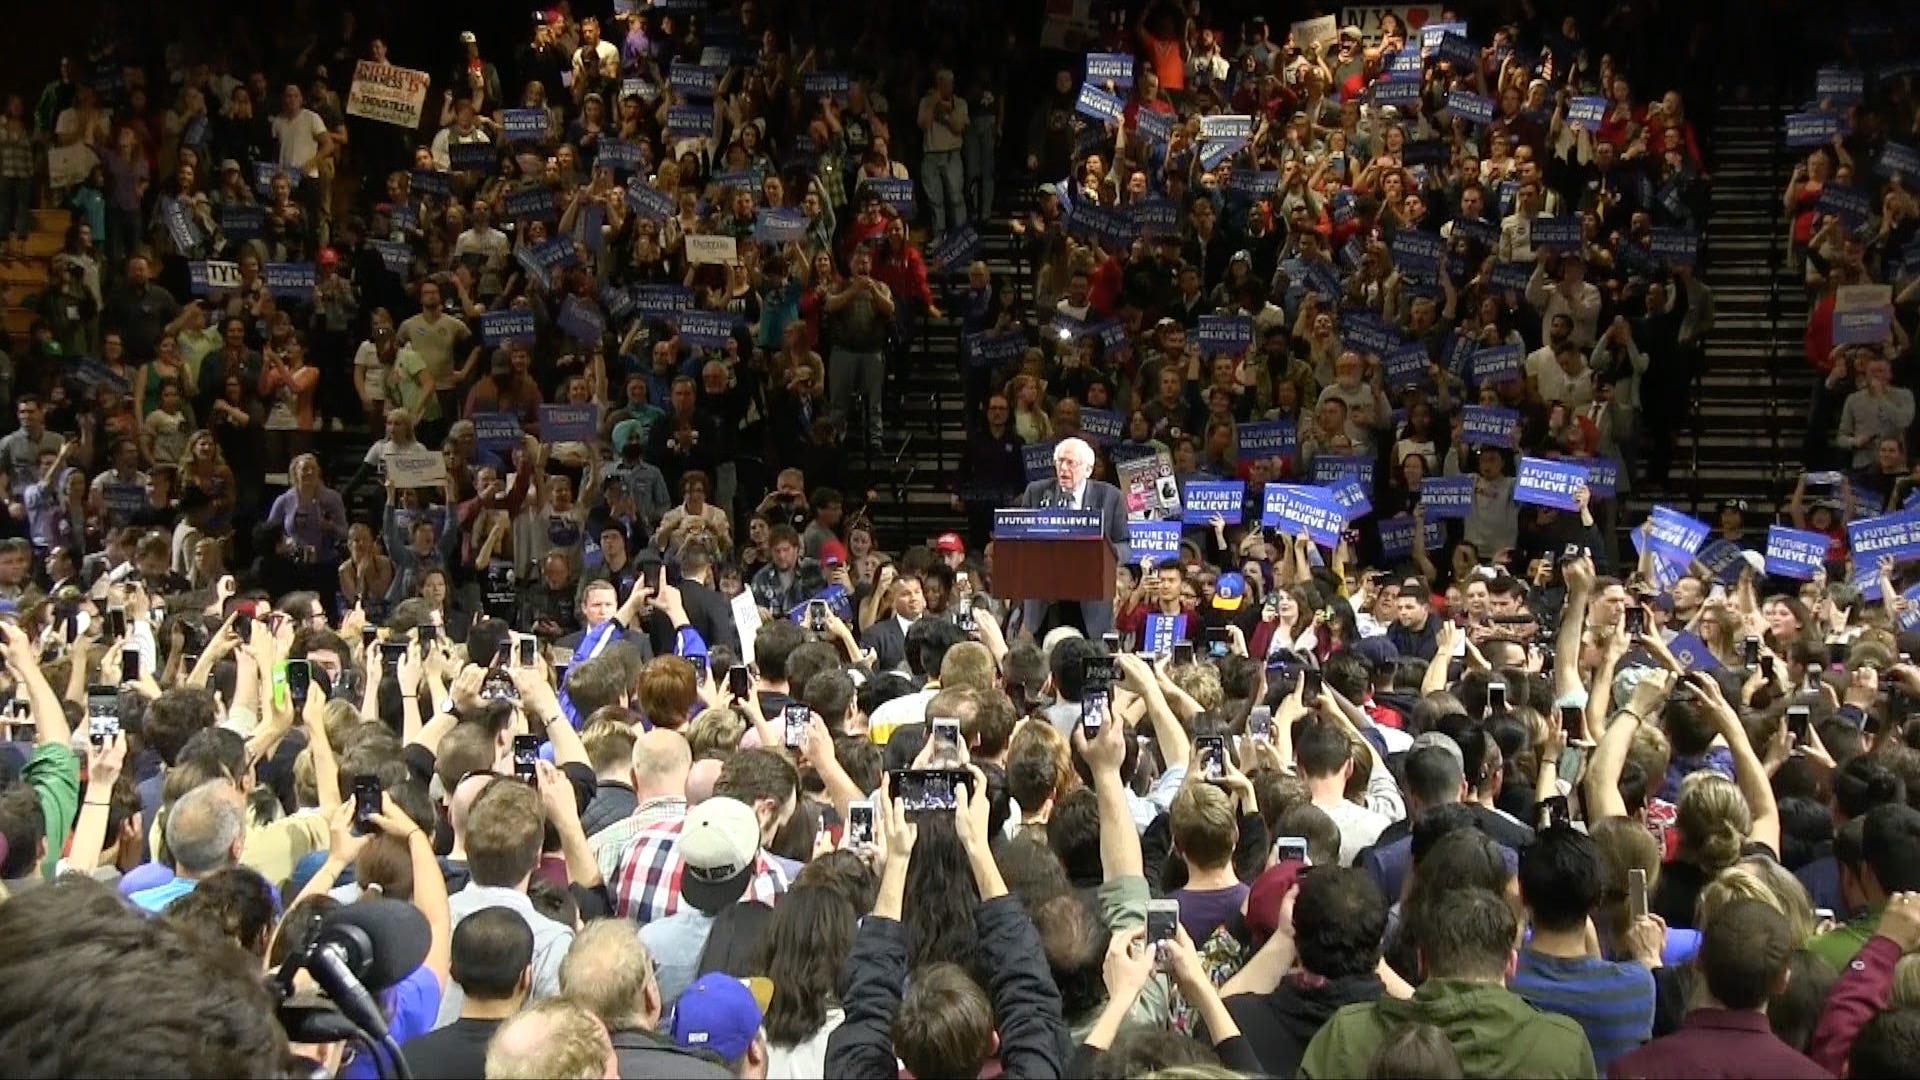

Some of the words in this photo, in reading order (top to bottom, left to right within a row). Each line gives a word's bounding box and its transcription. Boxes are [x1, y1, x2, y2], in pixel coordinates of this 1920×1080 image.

[485, 326, 522, 336] BELIEVE
[523, 324, 534, 332] IN
[681, 325, 719, 335] BELIEVE
[720, 328, 730, 337] IN
[1199, 330, 1237, 339] BELIEVE
[1239, 331, 1249, 340] IN
[1463, 422, 1501, 434] BELIEVE
[1241, 438, 1283, 448] BELIEVE
[1284, 436, 1296, 445] IN
[1360, 473, 1371, 482] IN
[1523, 467, 1529, 475] A
[1531, 469, 1567, 481] FUTURE
[1570, 476, 1584, 486] TO
[1603, 475, 1615, 485] IN
[1520, 476, 1566, 492] BELIEVE
[1188, 492, 1194, 500] A
[1196, 491, 1229, 500] FUTURE
[1231, 491, 1242, 500] TO
[1268, 493, 1274, 501] A
[1350, 491, 1364, 503] IN
[1421, 494, 1457, 504] BELIEVE
[1460, 495, 1471, 505] IN
[1187, 501, 1228, 510] BELIEVE
[1229, 501, 1241, 510] IN
[1289, 501, 1295, 509] A
[1295, 503, 1327, 517] FUTURE
[1329, 512, 1342, 522] TO
[1005, 517, 1039, 525] FUTURE
[1039, 517, 1049, 525] TO
[1050, 517, 1087, 525] BELIEVE
[1089, 517, 1099, 525] IN
[1285, 509, 1323, 528] BELIEVE
[1326, 521, 1340, 533] IN
[1132, 532, 1165, 540] UTURE
[1166, 532, 1179, 540] TO
[1854, 533, 1862, 541] A
[1864, 522, 1907, 539] FUTURE
[1131, 541, 1163, 549] LIEVE
[1166, 541, 1178, 550] IN
[1770, 536, 1774, 545] A
[1775, 538, 1808, 552] FUTURE
[1810, 544, 1823, 555] TO
[1855, 534, 1908, 552] BELIEVE
[1768, 545, 1806, 562] BELIEVE
[1807, 555, 1822, 566] IN
